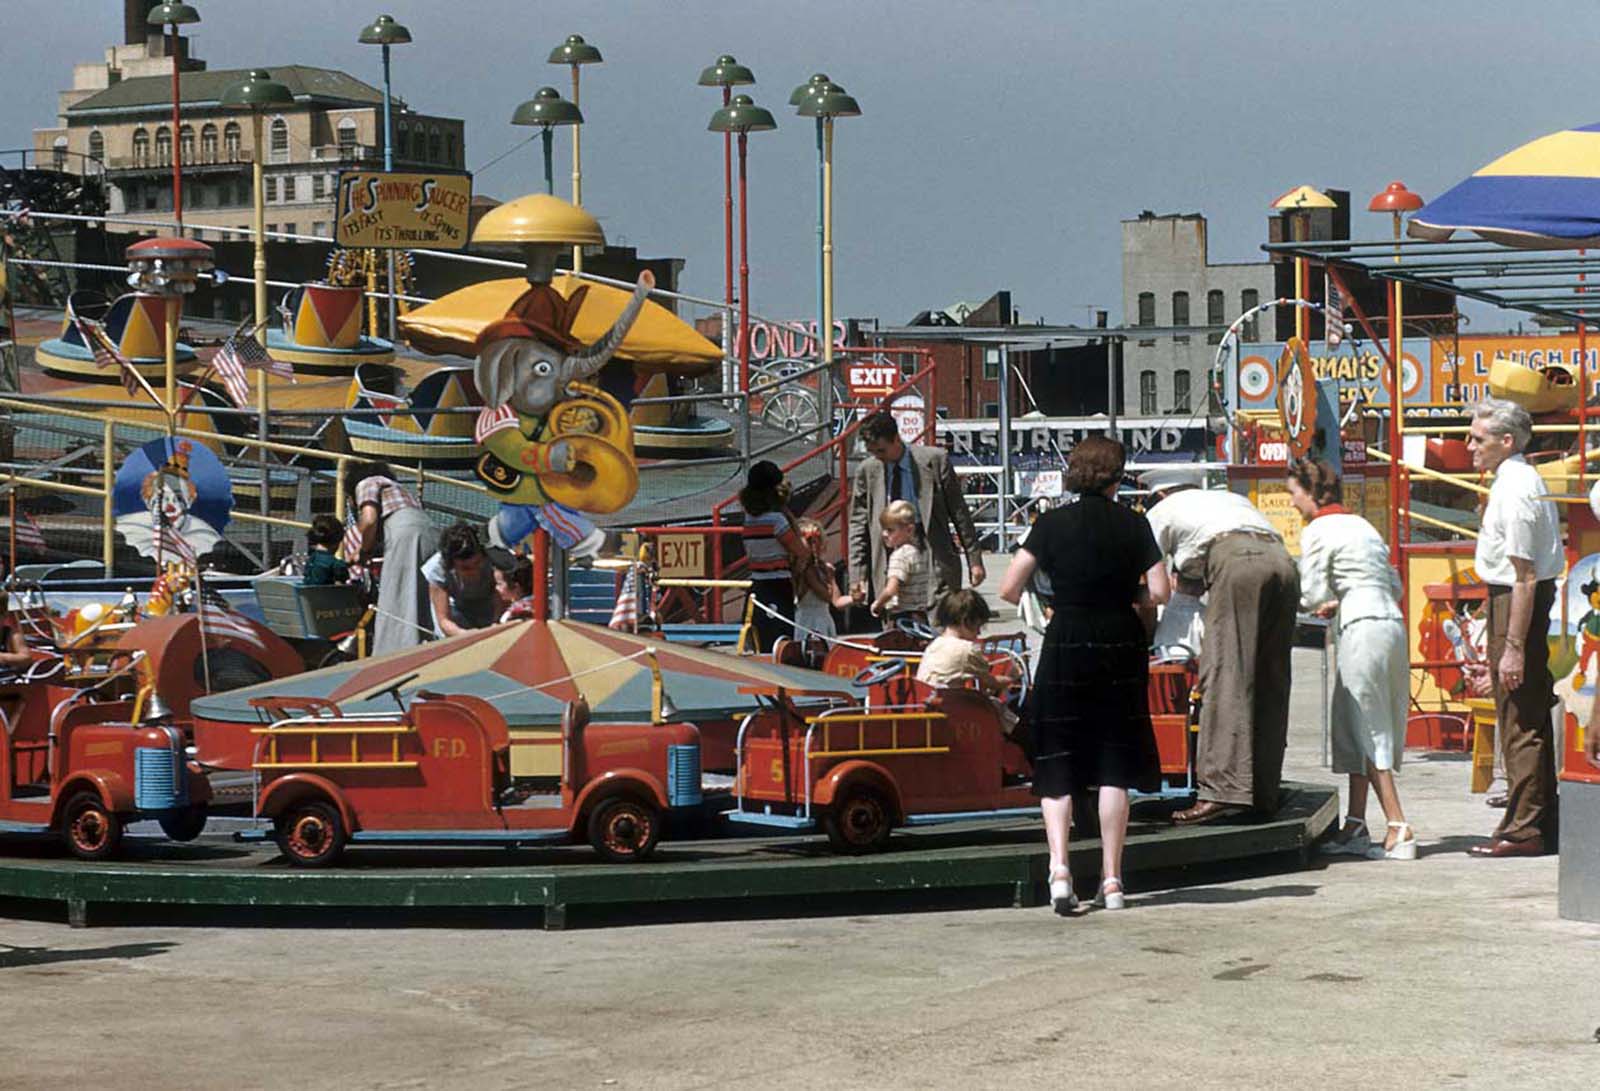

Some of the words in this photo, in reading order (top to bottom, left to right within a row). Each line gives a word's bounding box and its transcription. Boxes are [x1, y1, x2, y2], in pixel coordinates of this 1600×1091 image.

[362, 177, 422, 214] SPINNING
[414, 179, 467, 215] SAUCER
[850, 367, 897, 386] EXIT
[901, 427, 920, 435] NOT
[903, 417, 919, 426] DO
[1259, 442, 1287, 461] OPEN
[661, 541, 701, 568] EXIT
[770, 758, 783, 781] 5
